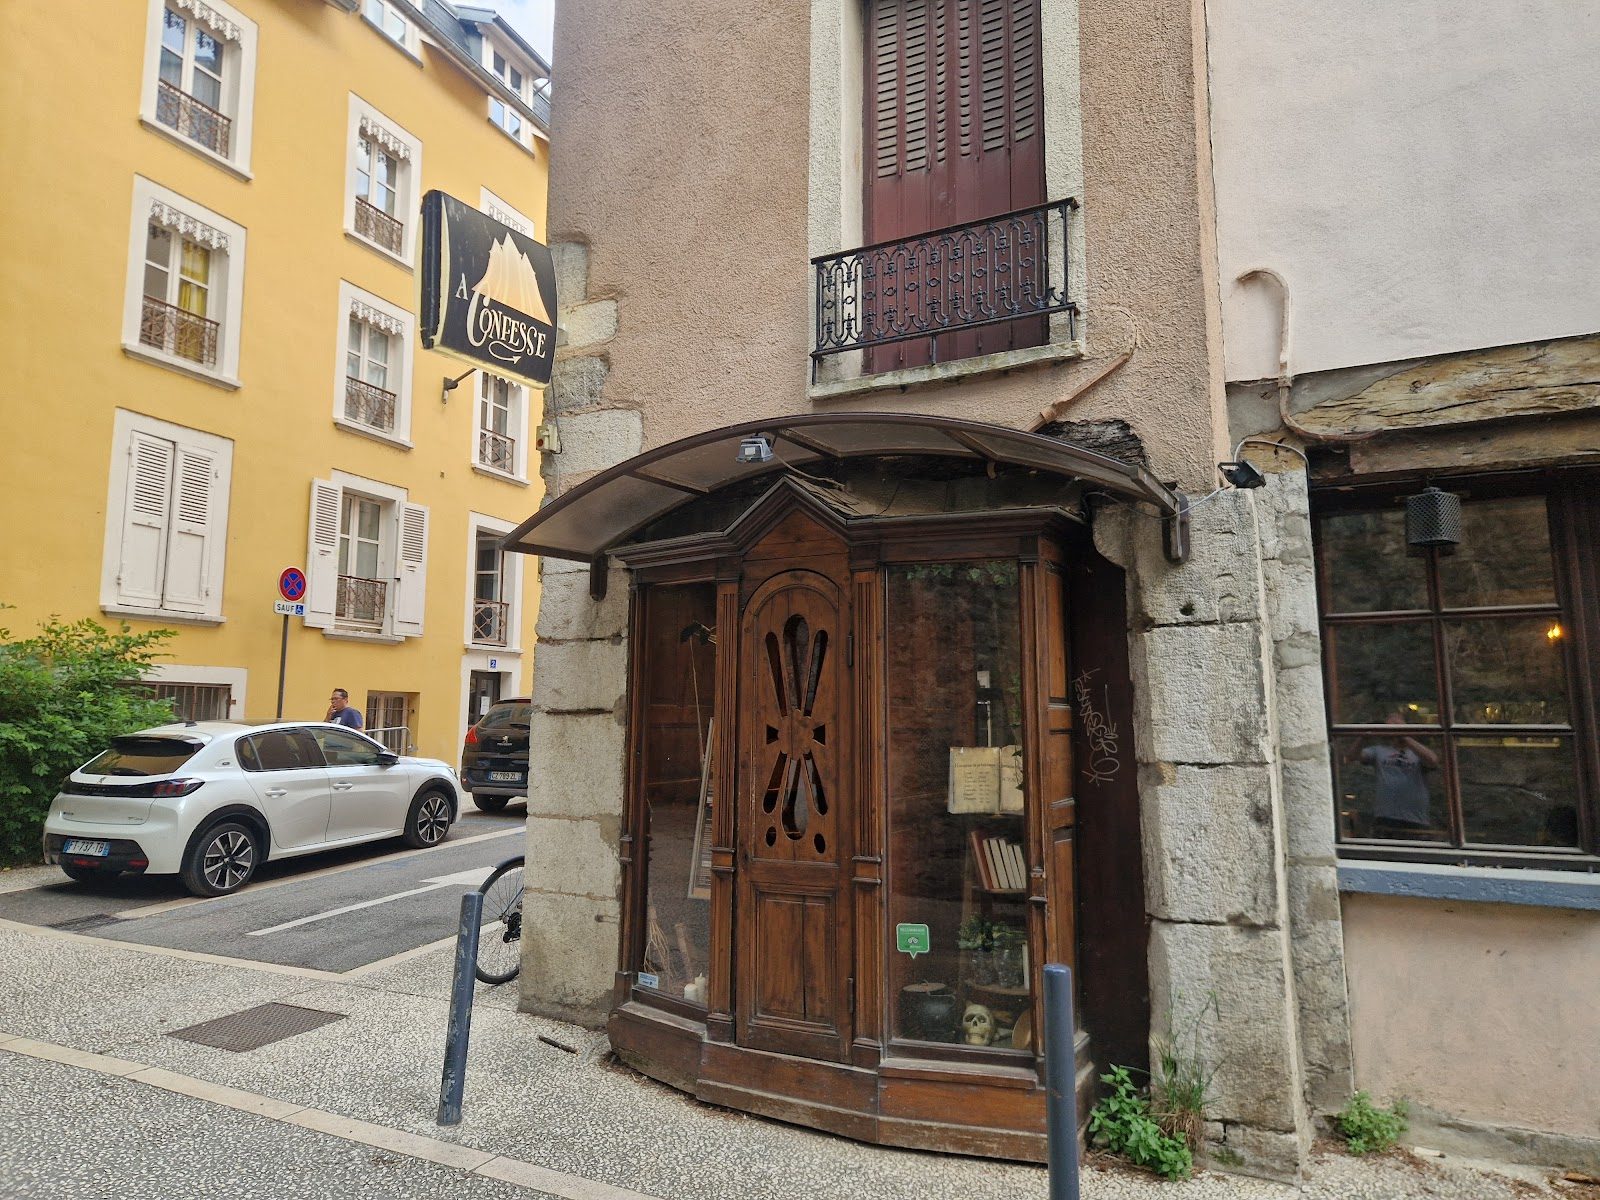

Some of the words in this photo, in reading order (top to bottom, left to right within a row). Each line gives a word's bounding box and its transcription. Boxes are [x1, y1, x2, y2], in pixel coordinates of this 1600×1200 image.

[455, 272, 469, 300] A
[466, 284, 546, 360] CONFESSE
[277, 603, 295, 612] SAUF
